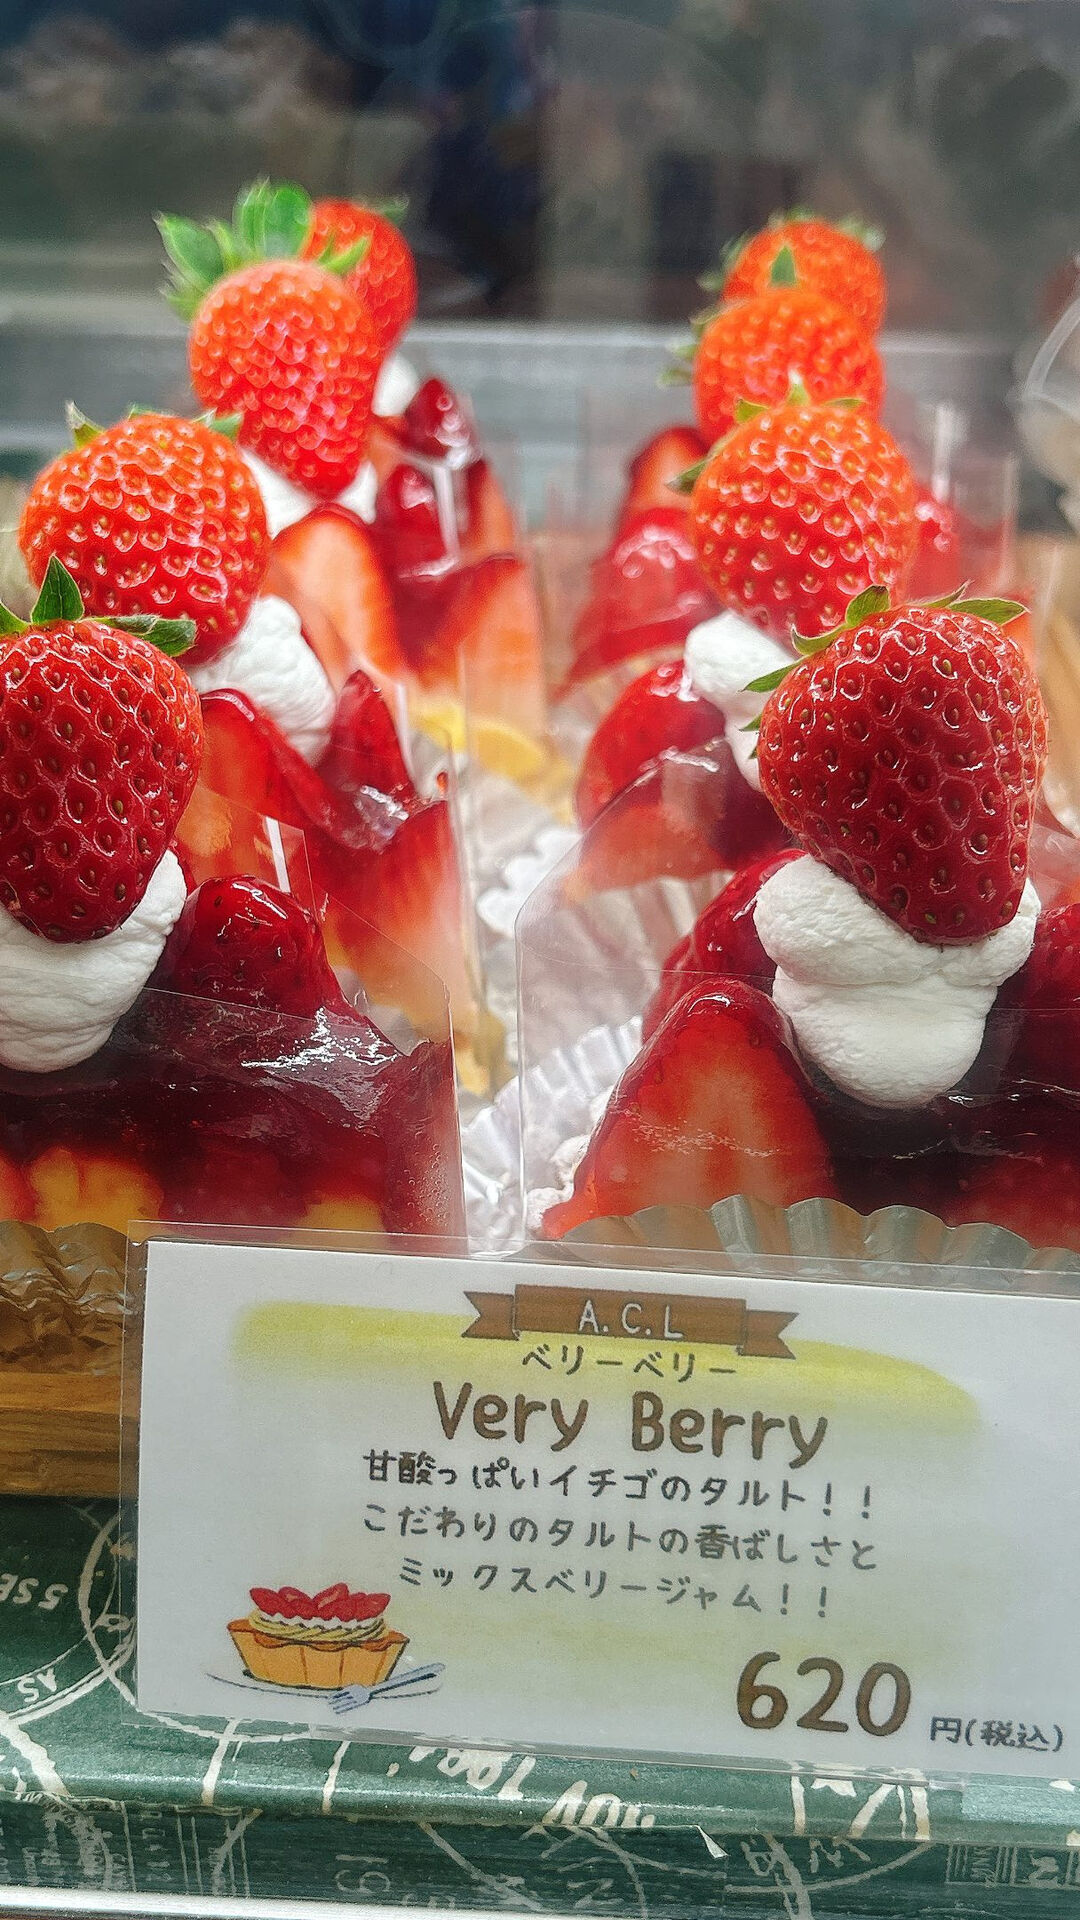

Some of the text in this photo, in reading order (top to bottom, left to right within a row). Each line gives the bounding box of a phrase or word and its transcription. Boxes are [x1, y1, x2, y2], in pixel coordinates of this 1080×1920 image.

[578, 1299, 684, 1340] A.C.L
[521, 1343, 737, 1384] ベリーベリー
[432, 1380, 829, 1470] Very Berry
[363, 1503, 878, 1571] こだわりのタルトの香ばしさと
[735, 1650, 1064, 1753] 620 円(税込)
